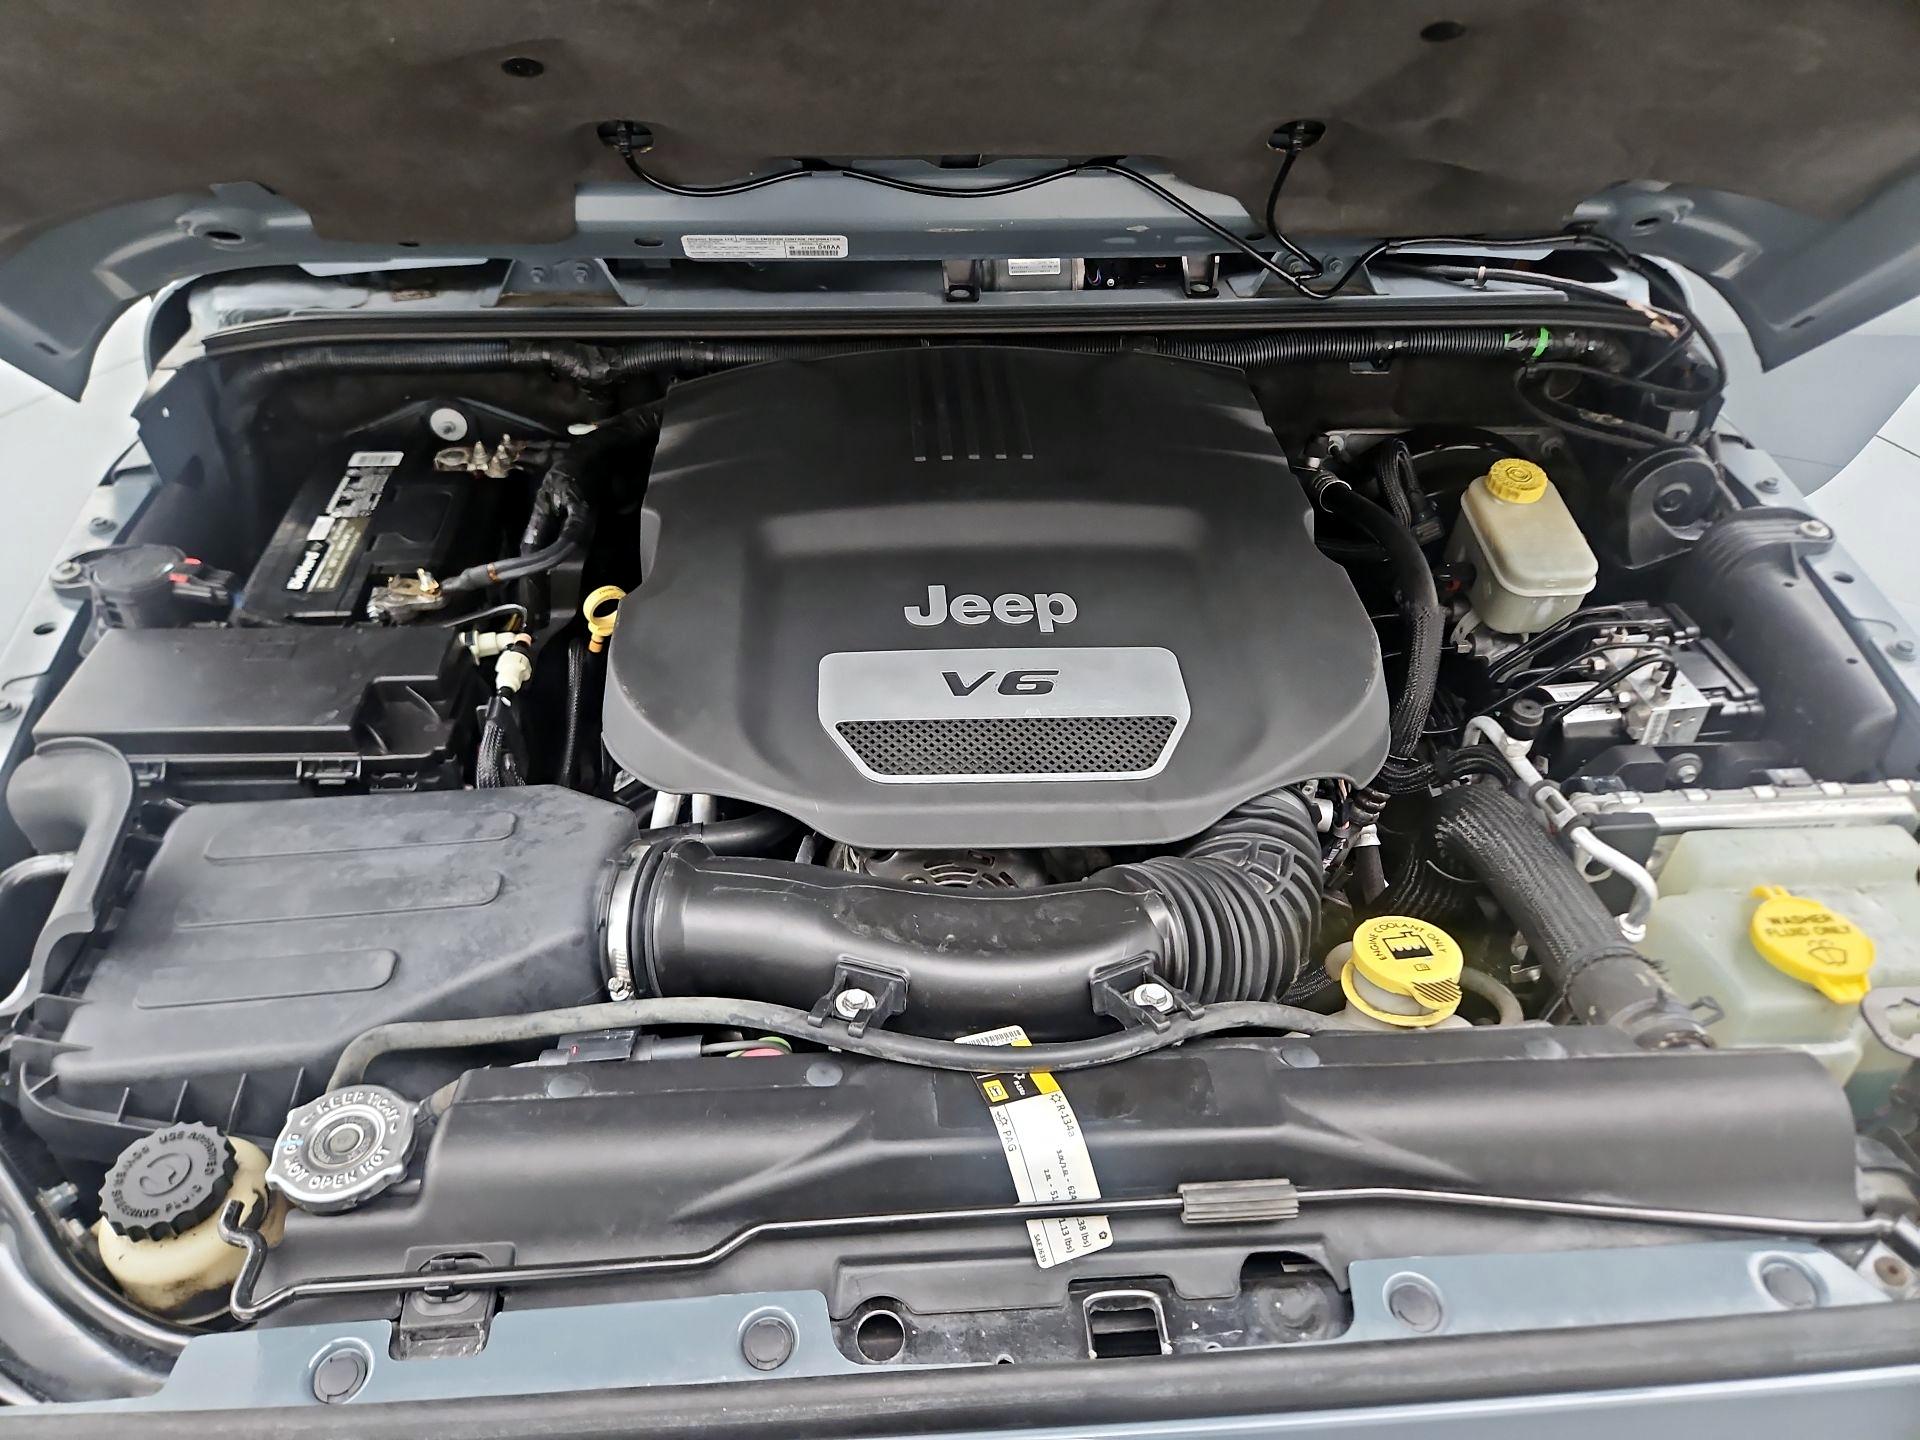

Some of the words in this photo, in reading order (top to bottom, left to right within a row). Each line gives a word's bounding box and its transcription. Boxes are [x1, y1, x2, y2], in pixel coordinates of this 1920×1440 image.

[903, 585, 1078, 633] Jeep
[941, 670, 1060, 697] V6
[1373, 922, 1425, 933] COOLANT
[1766, 914, 1834, 925] WASHER
[1426, 932, 1447, 953] ONLY
[1765, 926, 1810, 937] FLUID
[1812, 926, 1851, 937] ONLY
[1368, 933, 1388, 961] ENGINE
[316, 1091, 364, 1115] KEEP
[1056, 1104, 1075, 1137] R-134a
[1002, 1130, 1017, 1152] PAG
[159, 1130, 185, 1144] USE
[188, 1131, 218, 1176] APPROVED
[113, 1145, 150, 1186] POWER
[308, 1172, 357, 1190] OPEN
[359, 1145, 392, 1175] HOT
[111, 1189, 160, 1218] STEERING
[1076, 1218, 1087, 1231] .38
[1034, 1233, 1042, 1247] SAE
[1064, 1237, 1076, 1253] lbs)
[1081, 1232, 1092, 1248] lbs)
